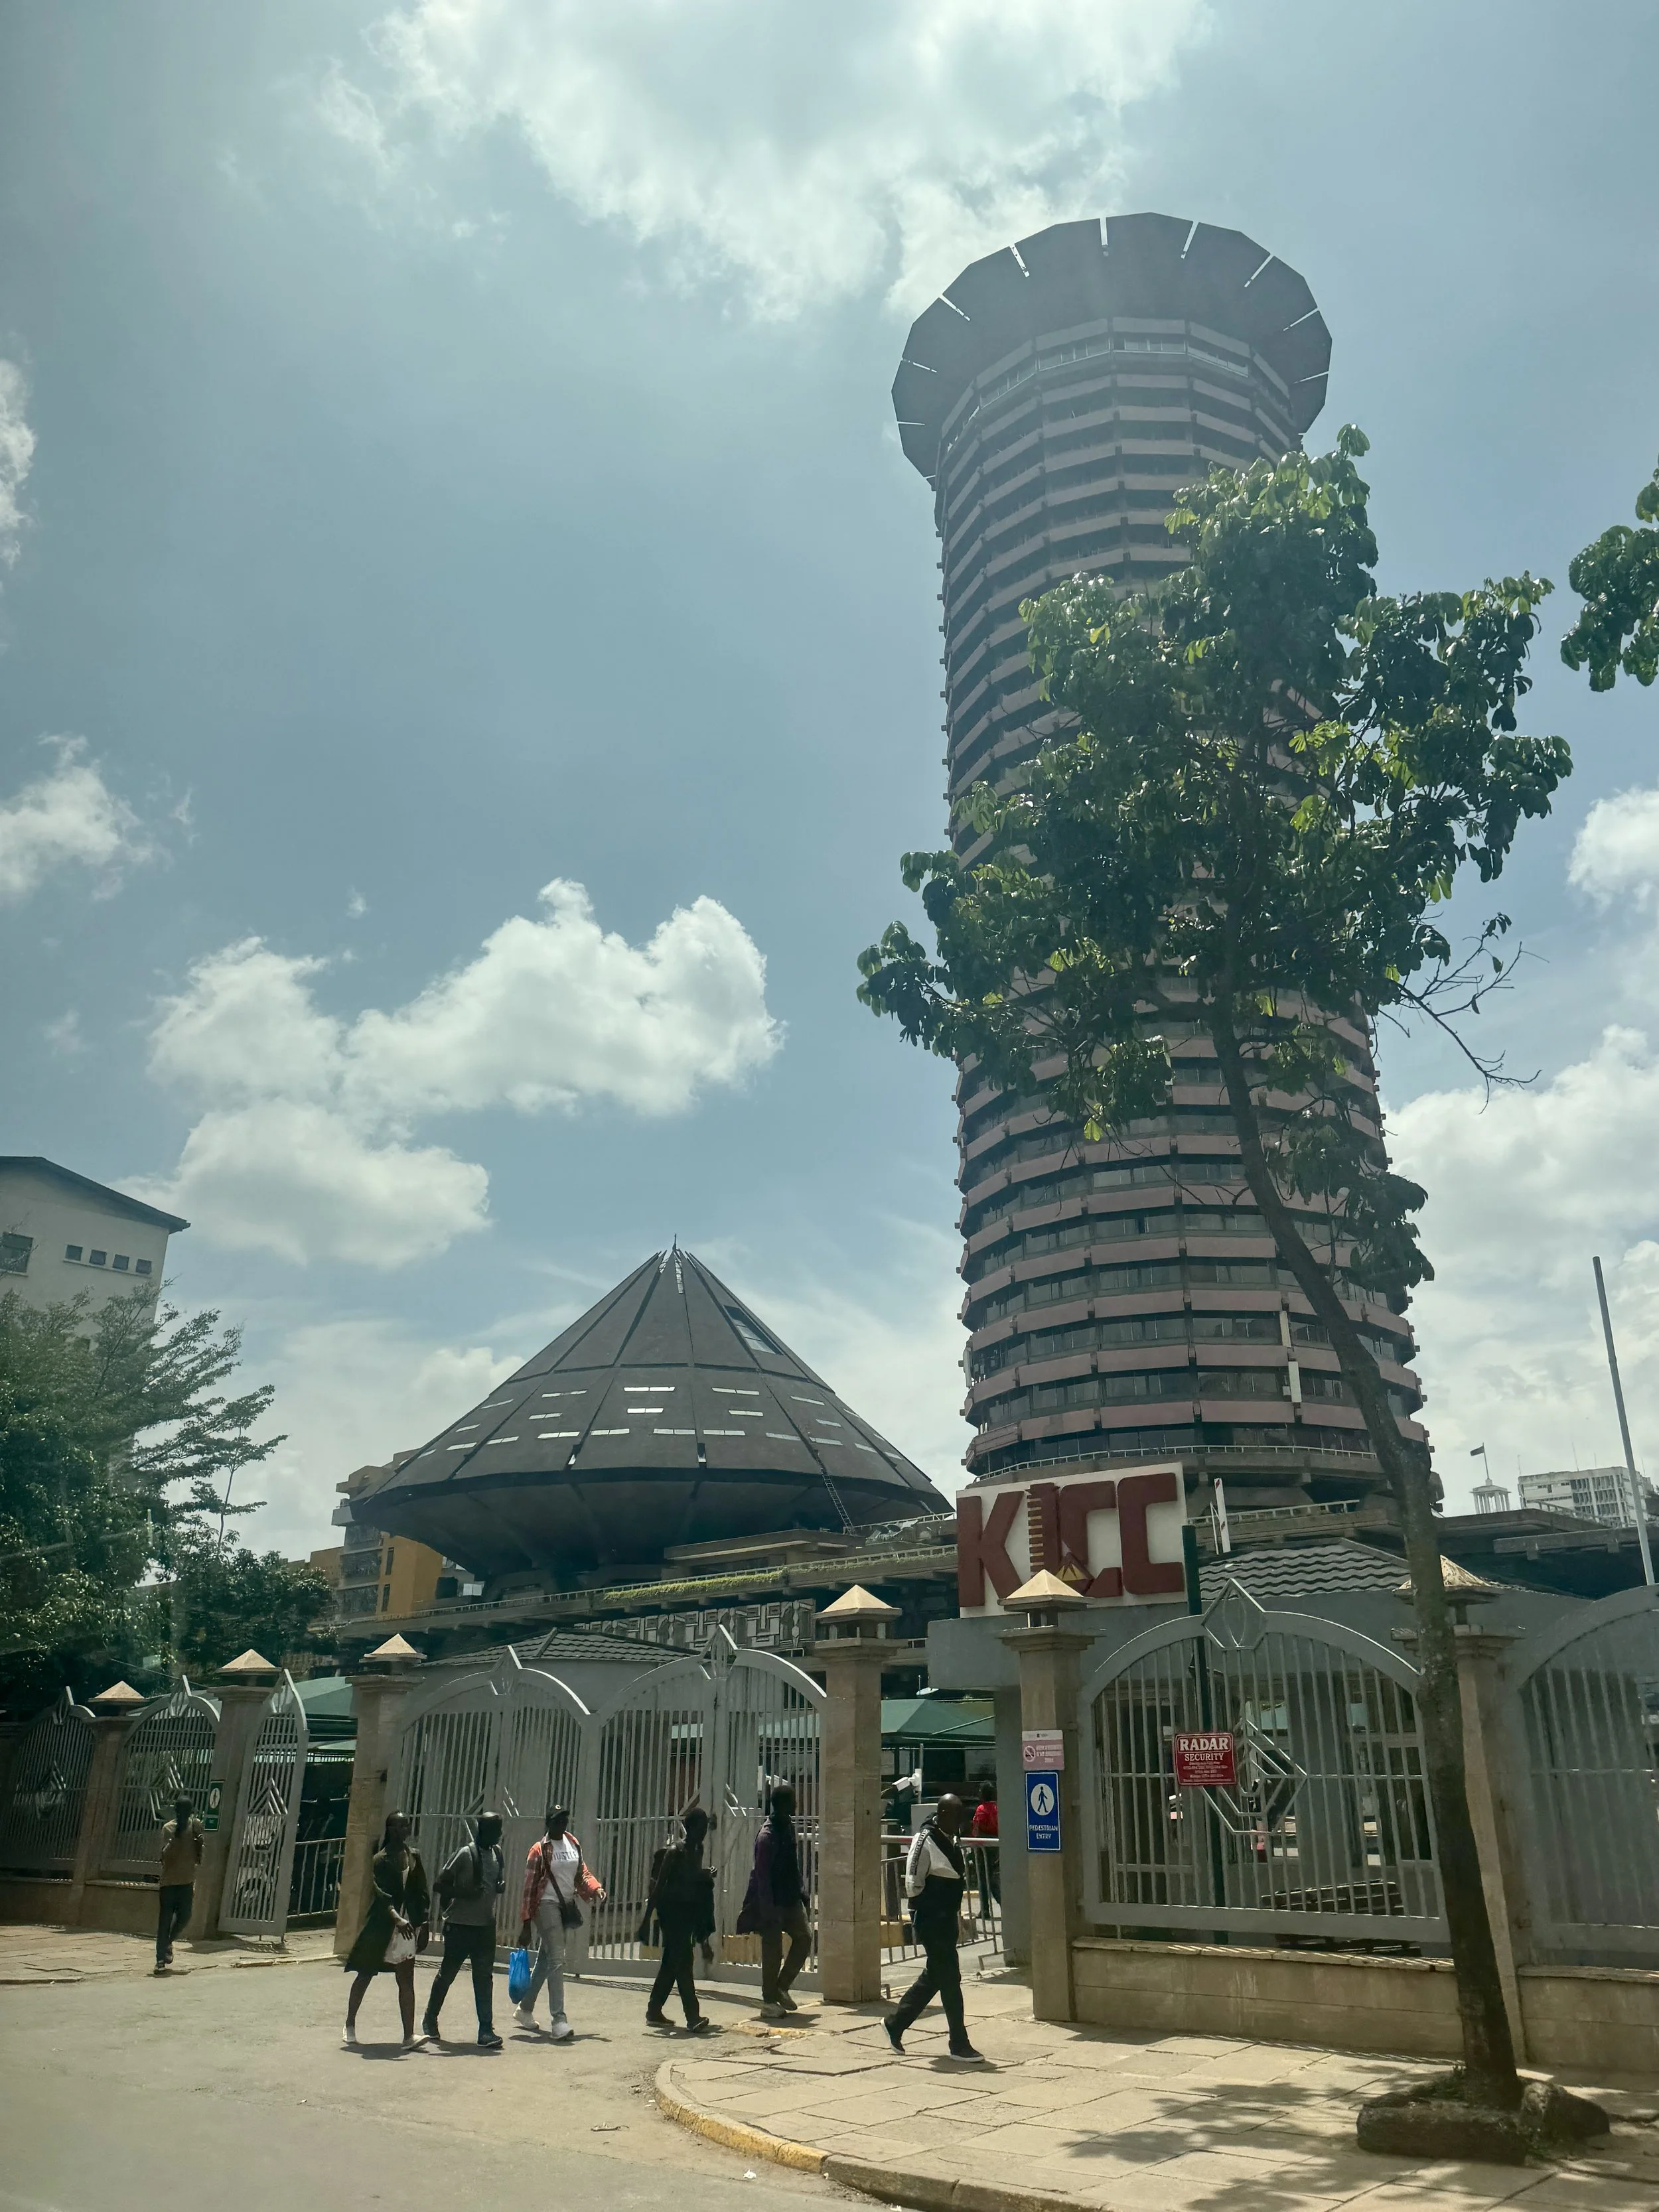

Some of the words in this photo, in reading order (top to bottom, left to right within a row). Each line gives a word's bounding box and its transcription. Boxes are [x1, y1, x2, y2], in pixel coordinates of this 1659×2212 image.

[956, 1472, 1185, 1607] KICC
[1179, 1738, 1229, 1752] RADAR
[1184, 1752, 1224, 1762] SECURITY
